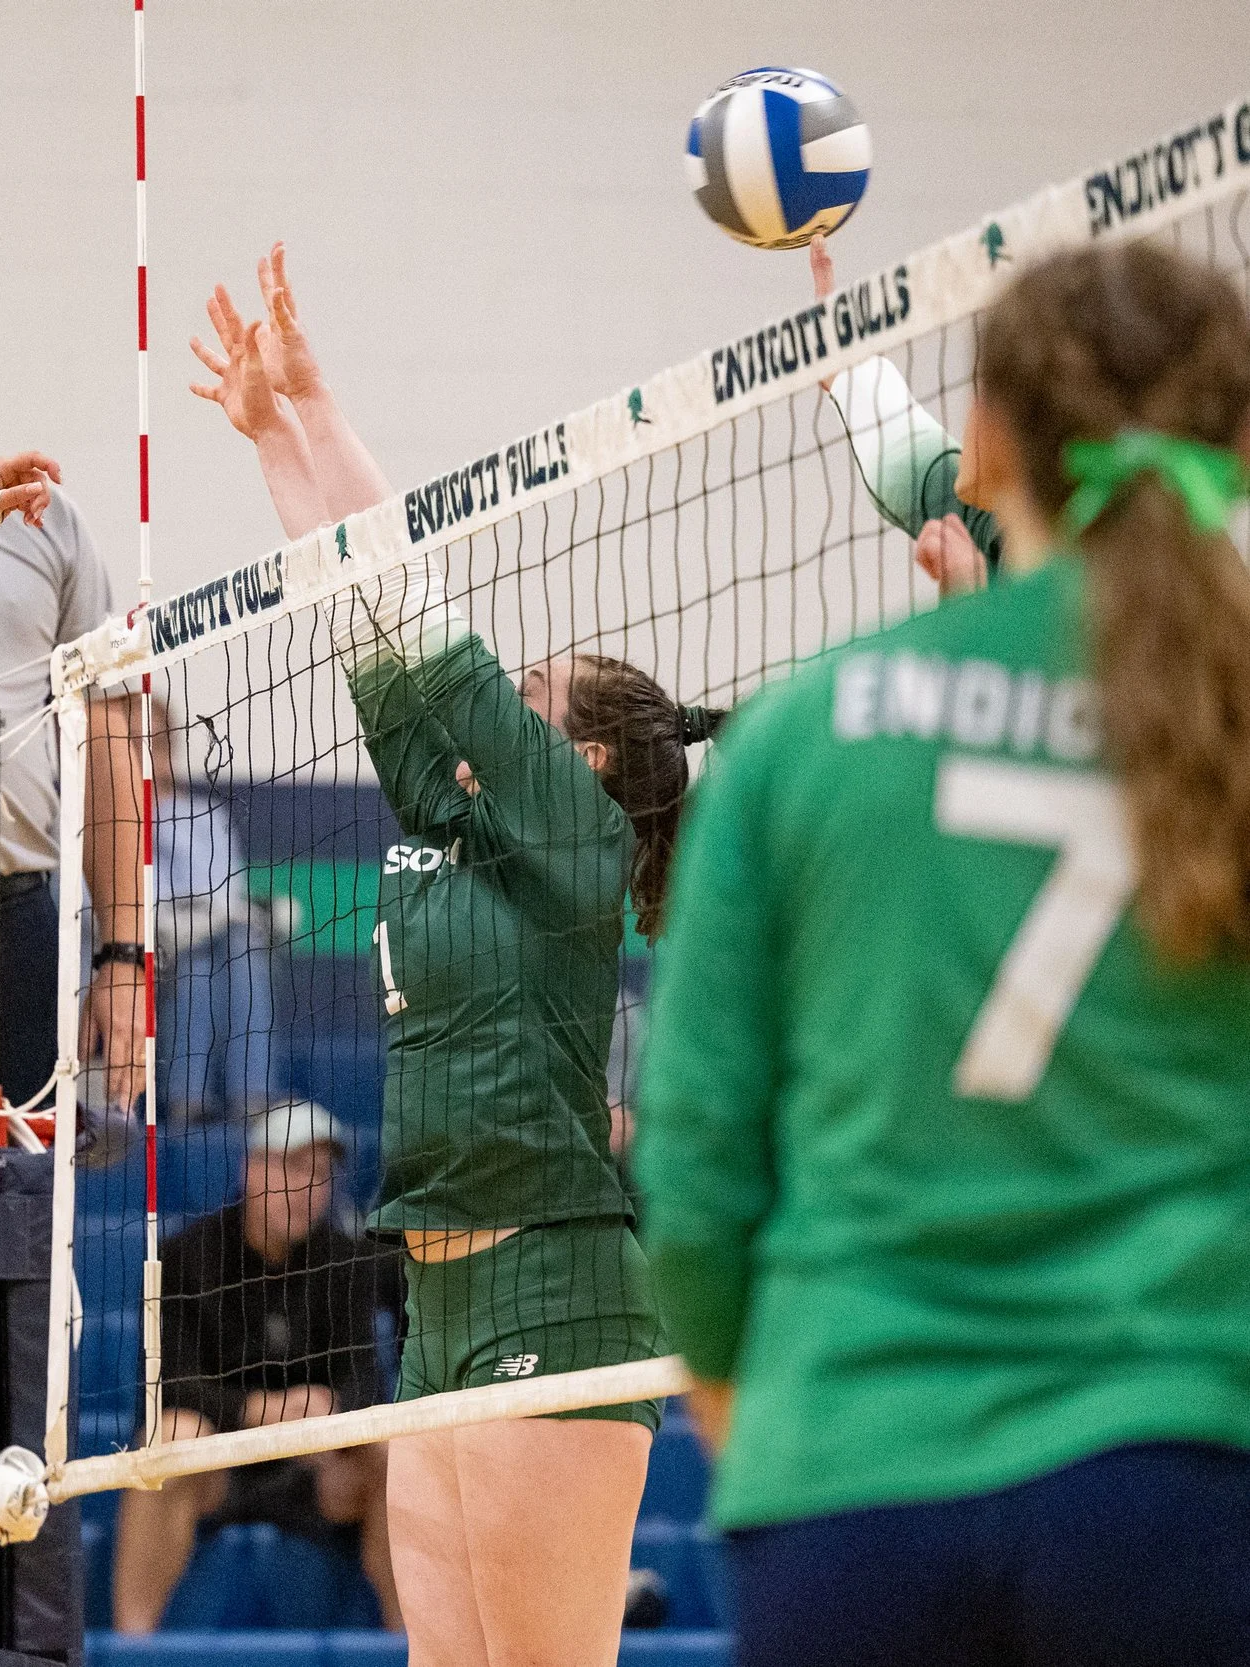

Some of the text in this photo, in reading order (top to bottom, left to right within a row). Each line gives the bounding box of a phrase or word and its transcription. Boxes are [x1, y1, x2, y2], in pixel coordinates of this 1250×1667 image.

[834, 264, 911, 350] GULLS
[833, 648, 1104, 761] ENDIC
[934, 750, 1142, 1102] 7
